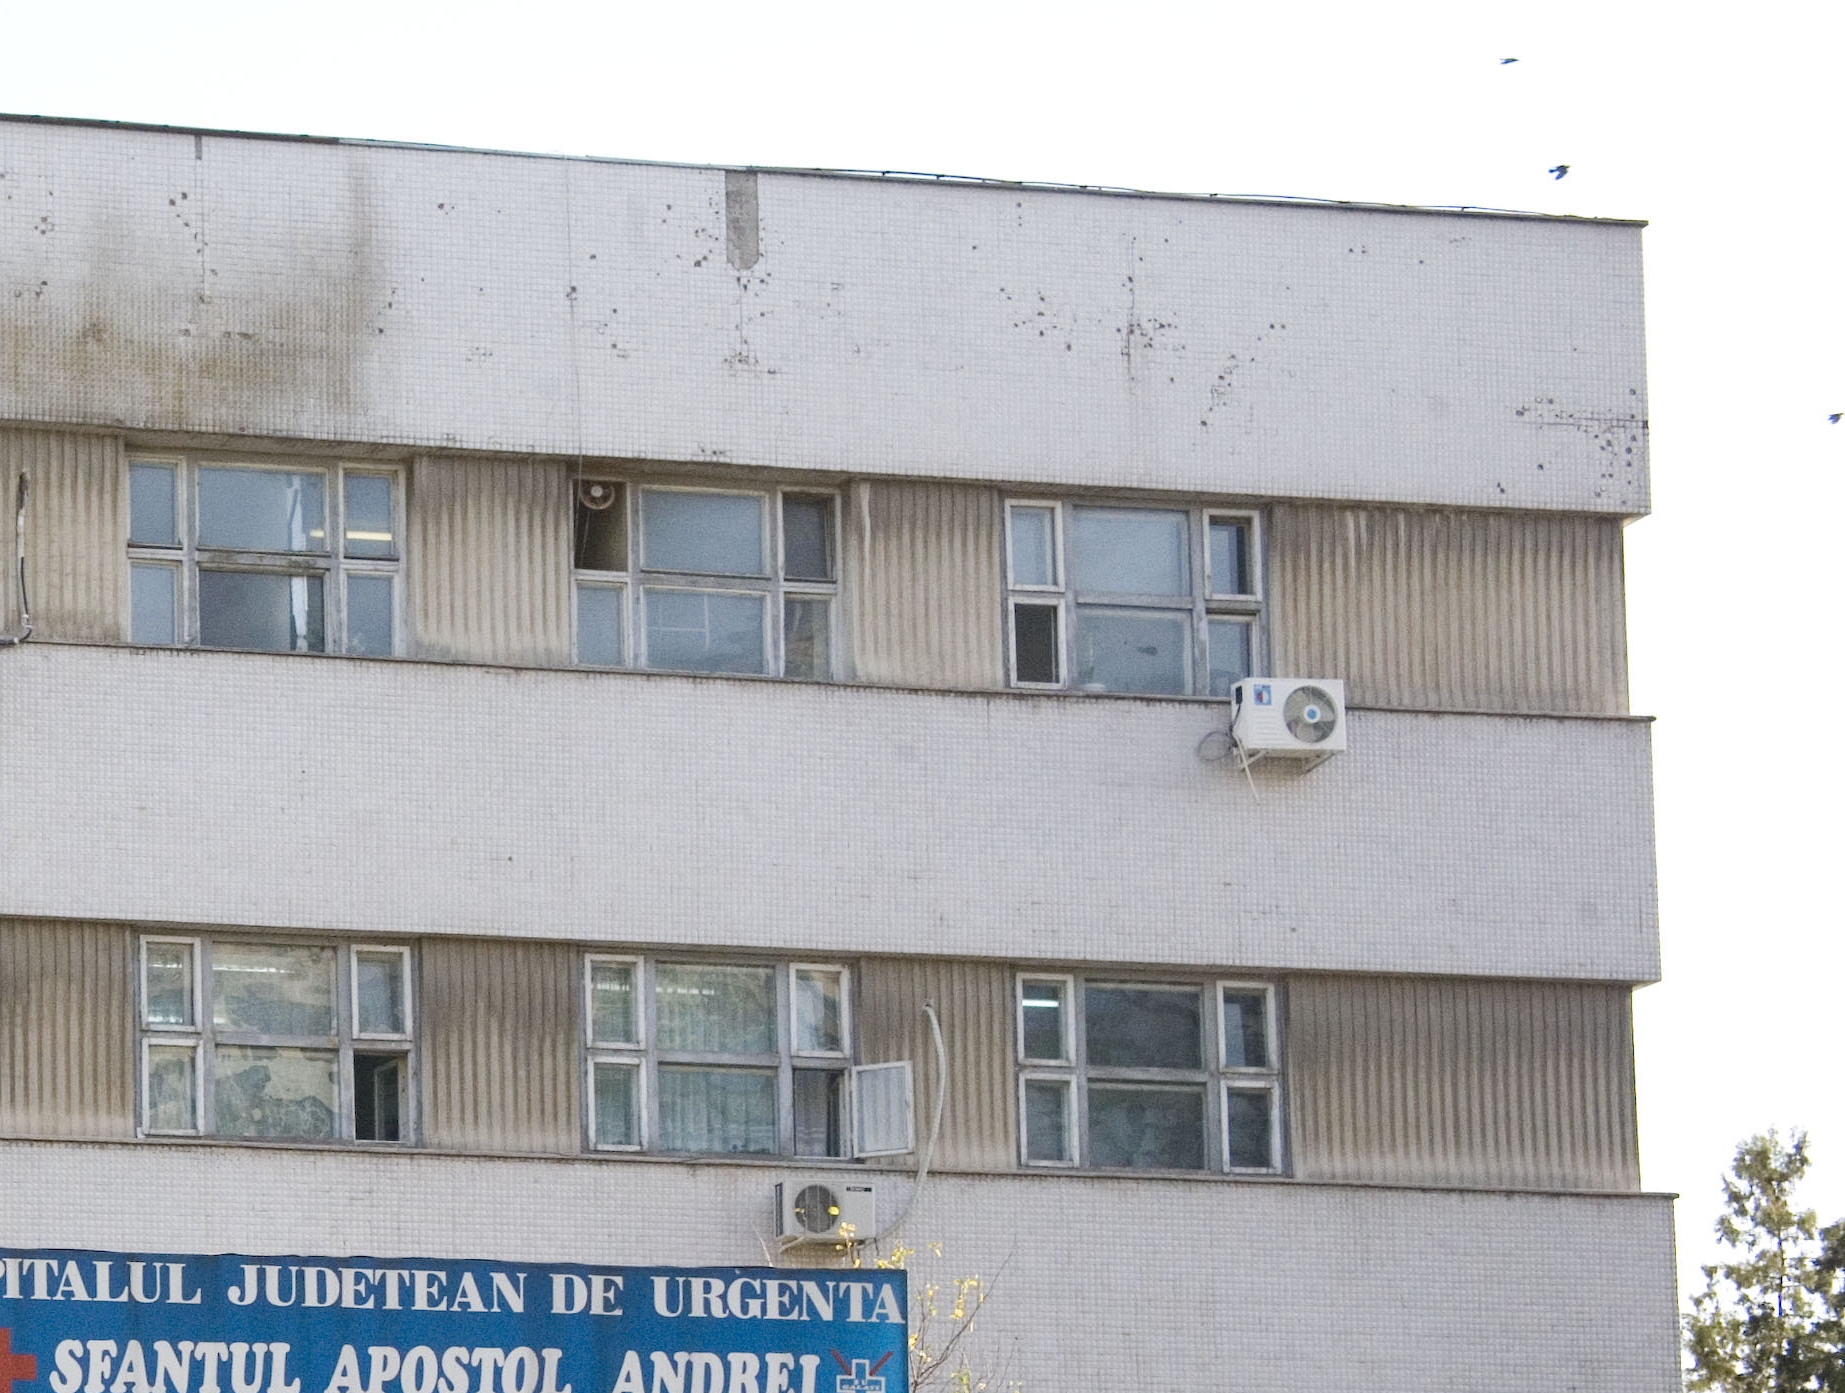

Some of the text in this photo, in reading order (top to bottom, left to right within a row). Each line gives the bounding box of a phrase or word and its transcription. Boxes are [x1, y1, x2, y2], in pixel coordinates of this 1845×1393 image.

[227, 1264, 527, 1313] JUDETEAN
[549, 1273, 624, 1316] DE
[650, 1276, 906, 1324] URGENTA
